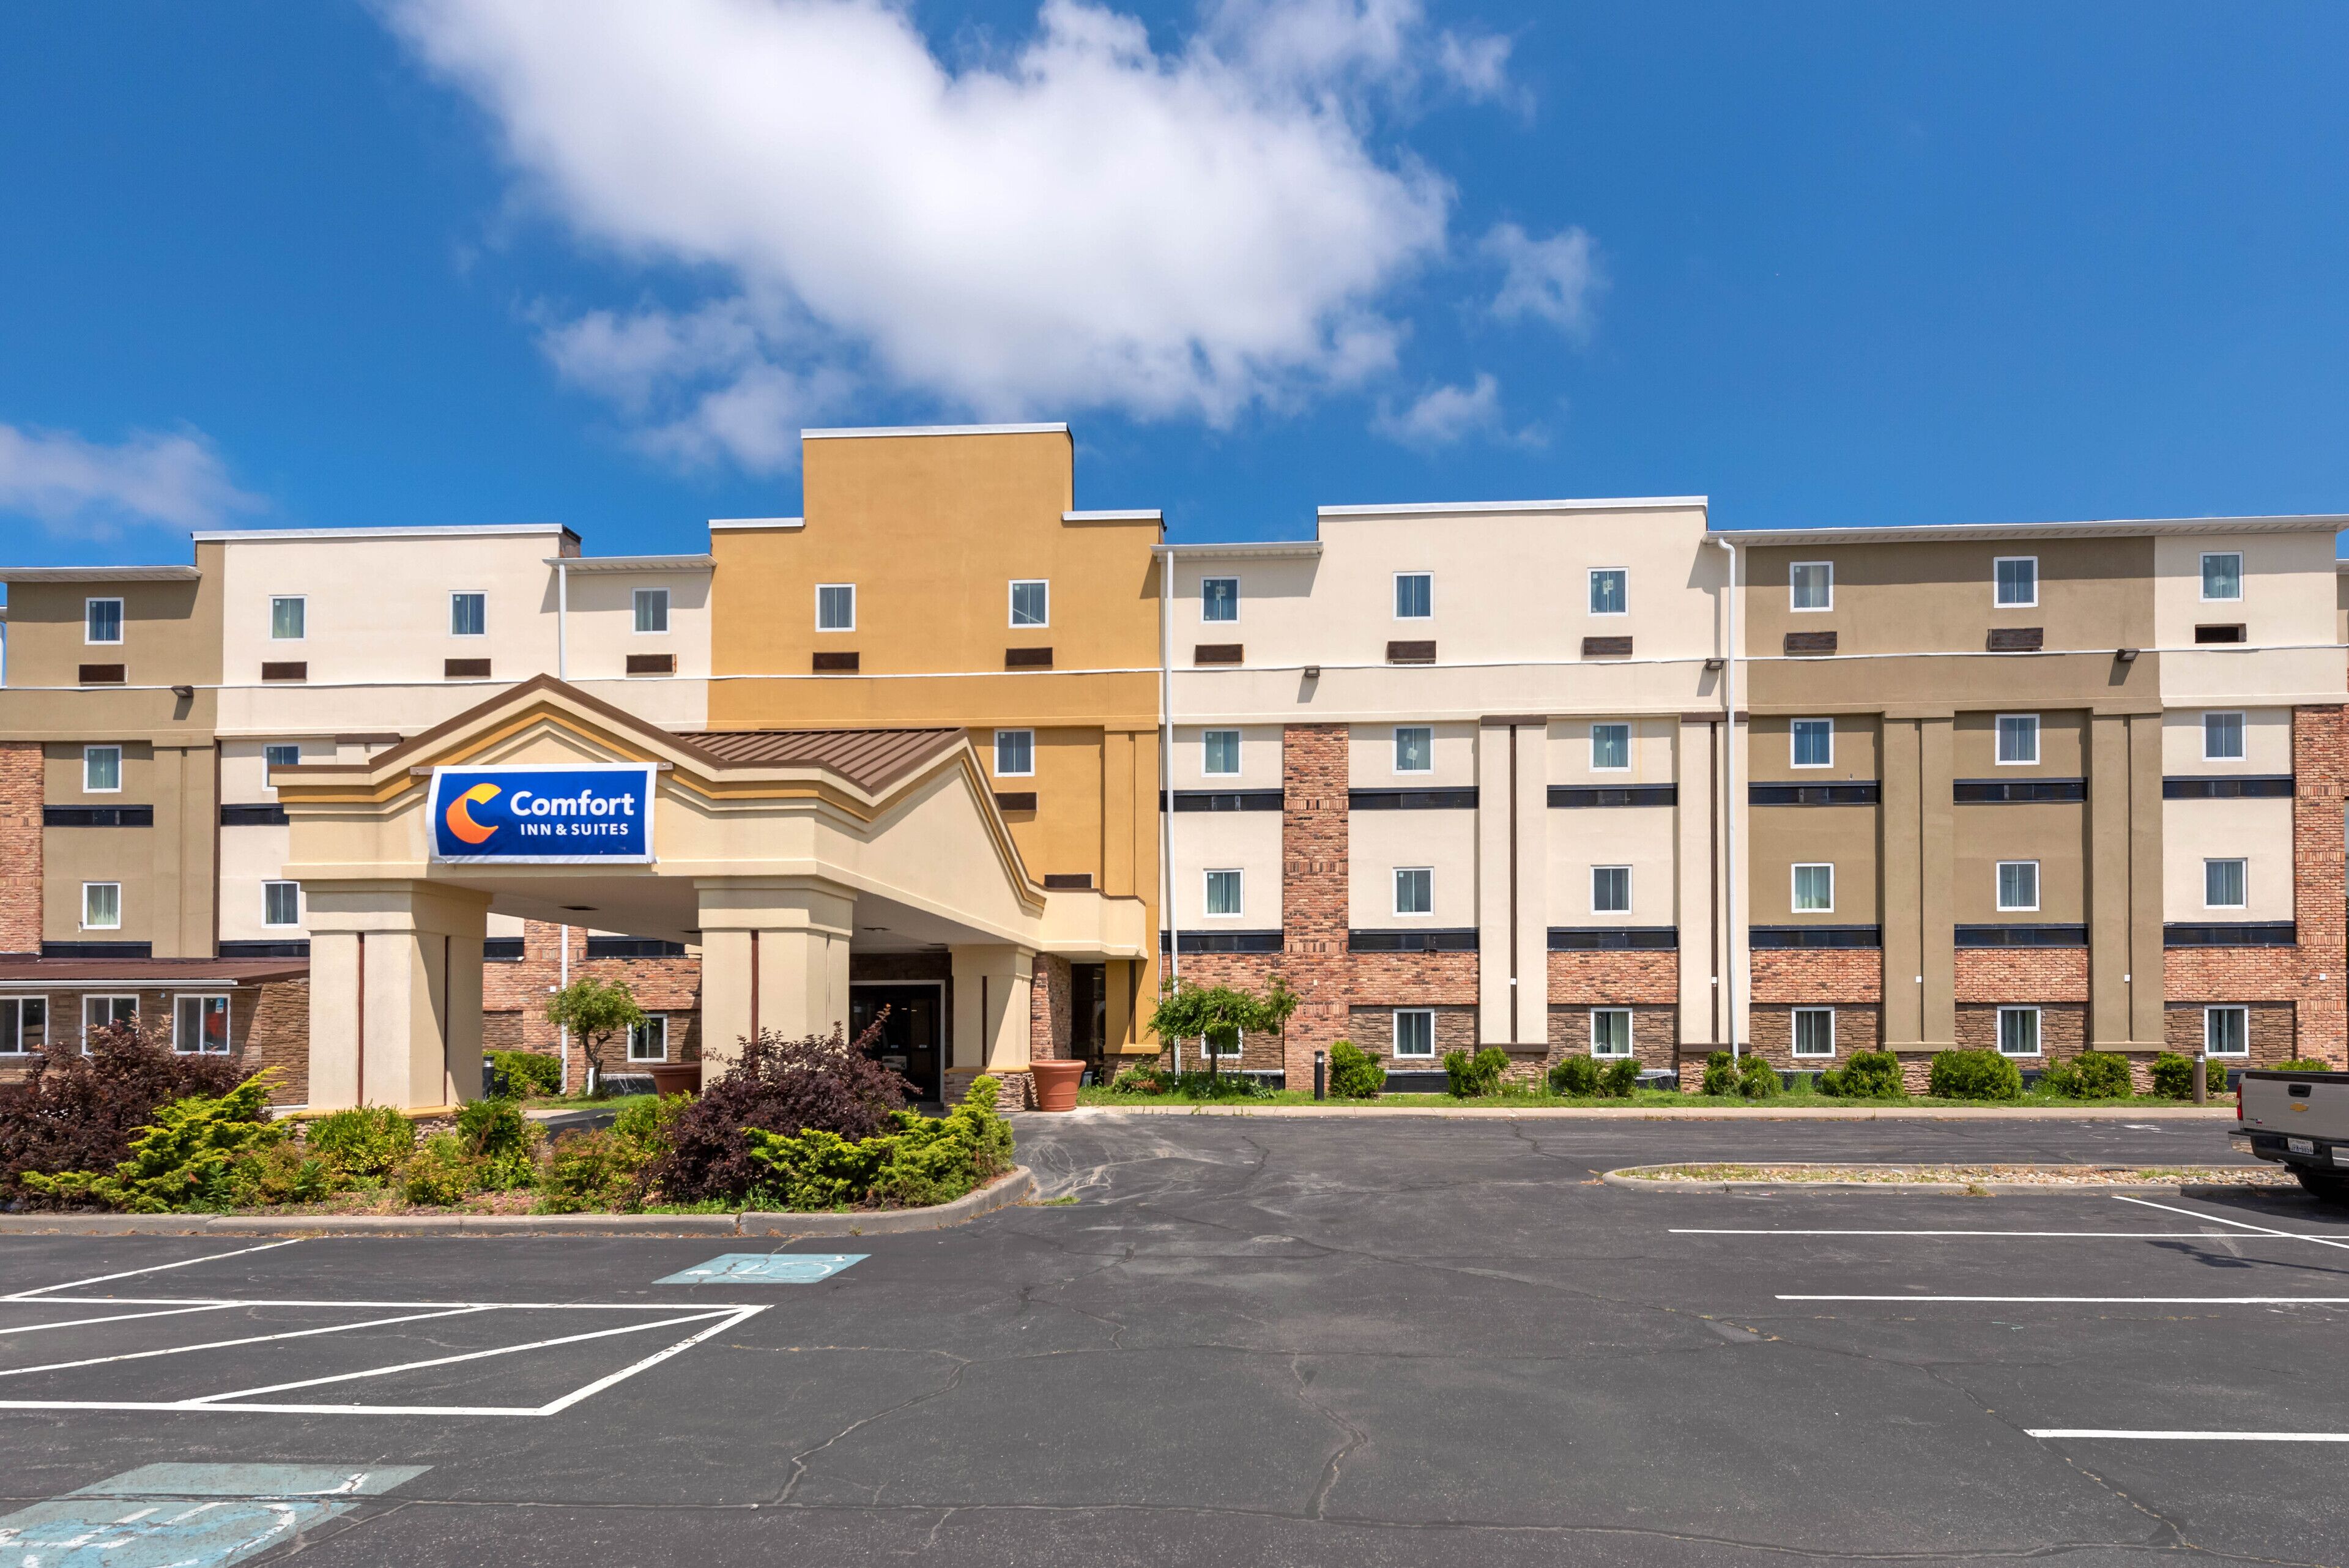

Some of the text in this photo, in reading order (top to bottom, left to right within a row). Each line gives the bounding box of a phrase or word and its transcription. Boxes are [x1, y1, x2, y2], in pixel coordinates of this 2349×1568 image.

[510, 789, 635, 816] Comfort
[521, 823, 629, 836] INN & SUITES
